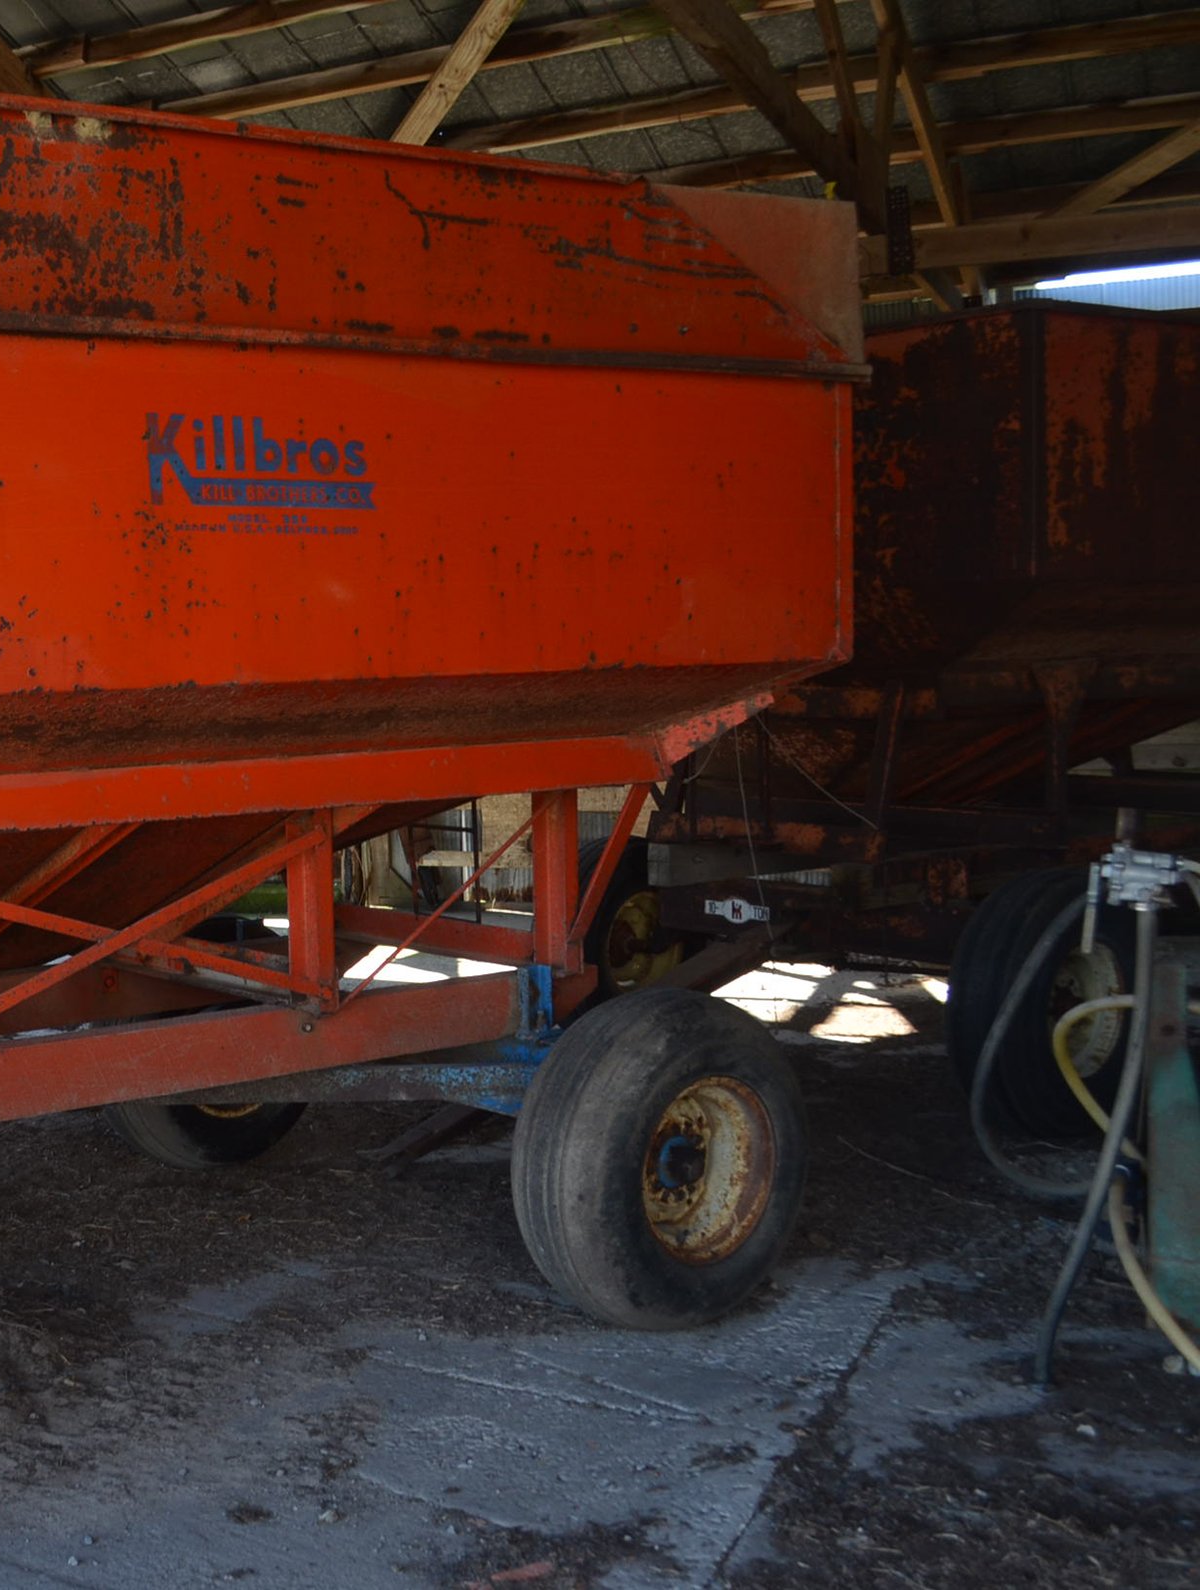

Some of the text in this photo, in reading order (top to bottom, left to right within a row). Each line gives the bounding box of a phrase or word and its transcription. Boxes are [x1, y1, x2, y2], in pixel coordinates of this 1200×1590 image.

[145, 411, 368, 505] Killbros
[201, 486, 367, 505] KILL BROTHERS CO.
[753, 907, 769, 920] TON
